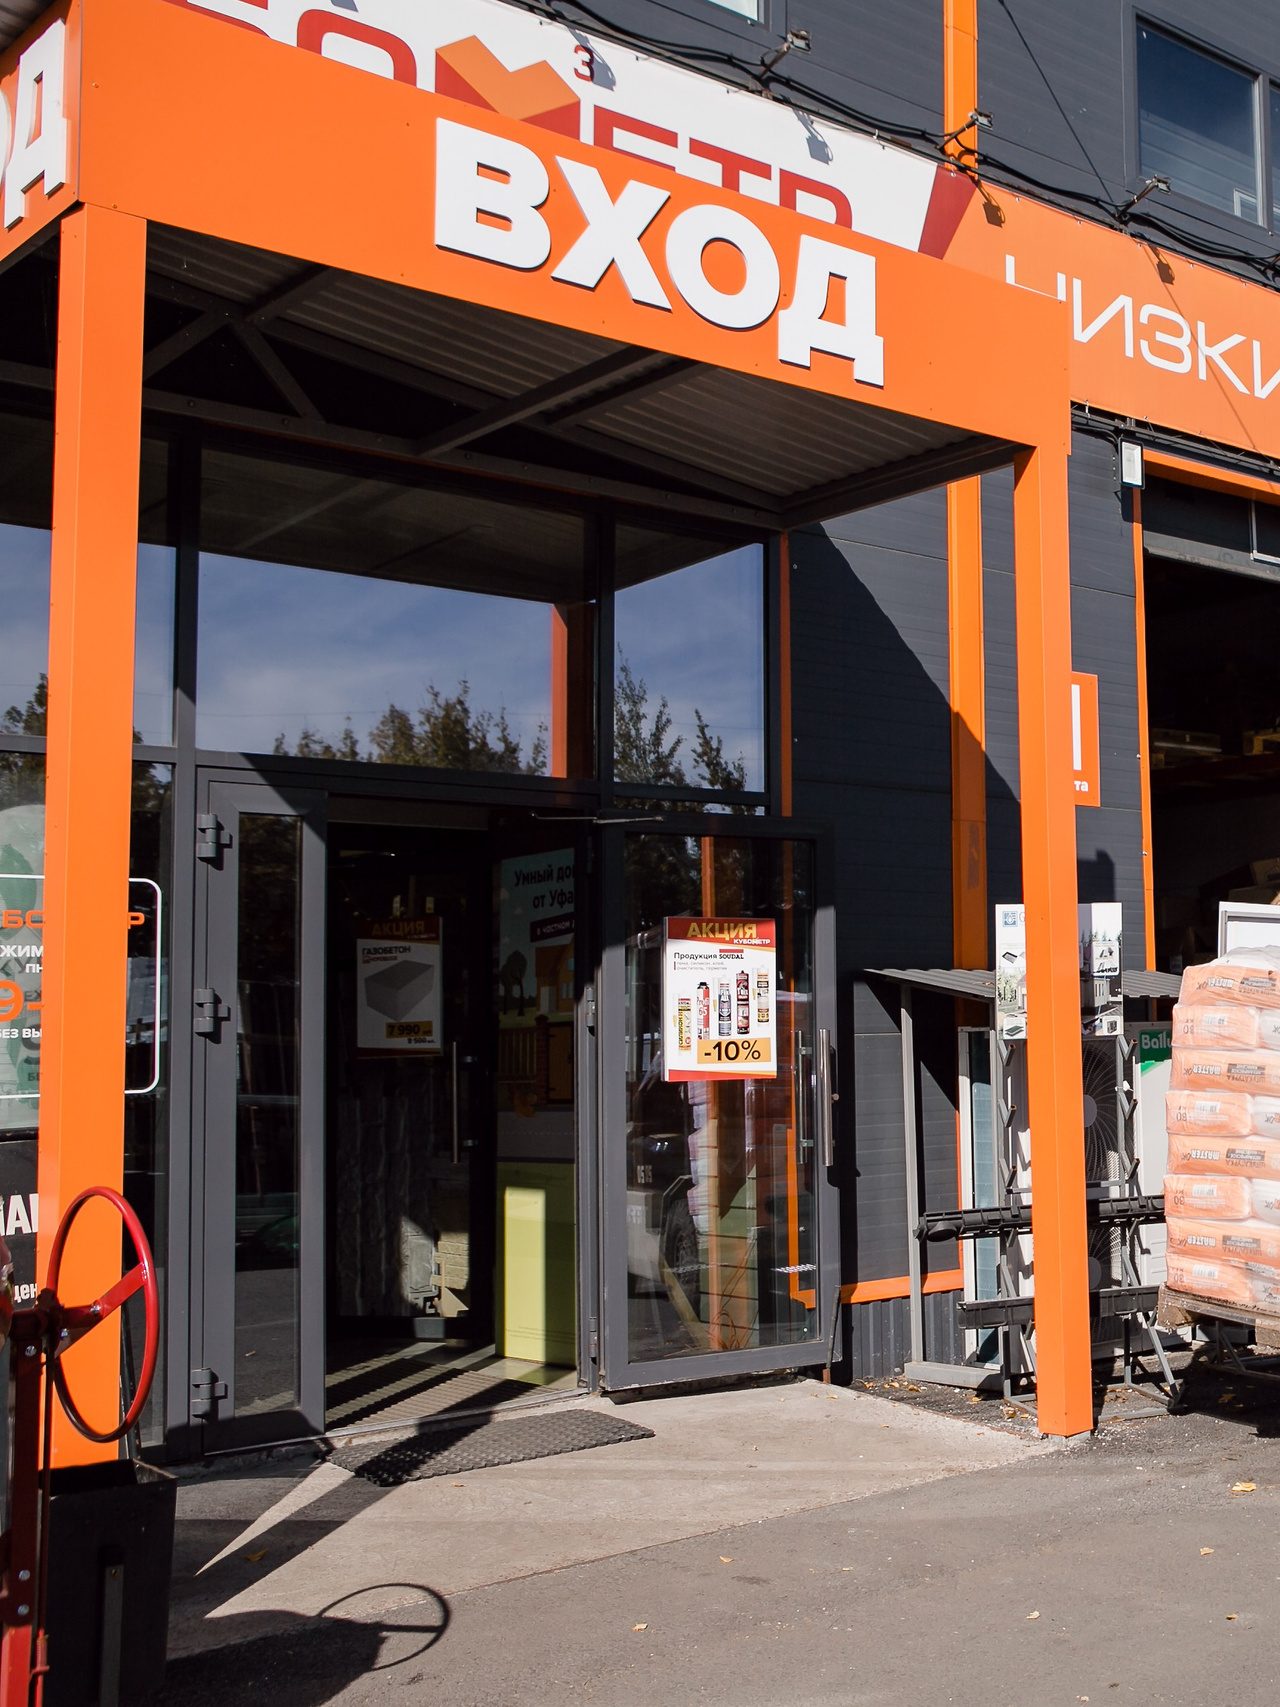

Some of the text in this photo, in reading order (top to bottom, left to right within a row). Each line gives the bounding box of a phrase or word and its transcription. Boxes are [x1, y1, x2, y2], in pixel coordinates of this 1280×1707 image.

[436, 116, 885, 388] ВХОД
[514, 864, 554, 887] Умный
[532, 894, 546, 909] от
[371, 920, 426, 937] АКЦИЯ
[686, 922, 757, 941] АКЦИЯ
[361, 945, 411, 956] ГАЗОБЕТОН
[673, 952, 718, 961] Продукция
[704, 1040, 761, 1062] -10%
